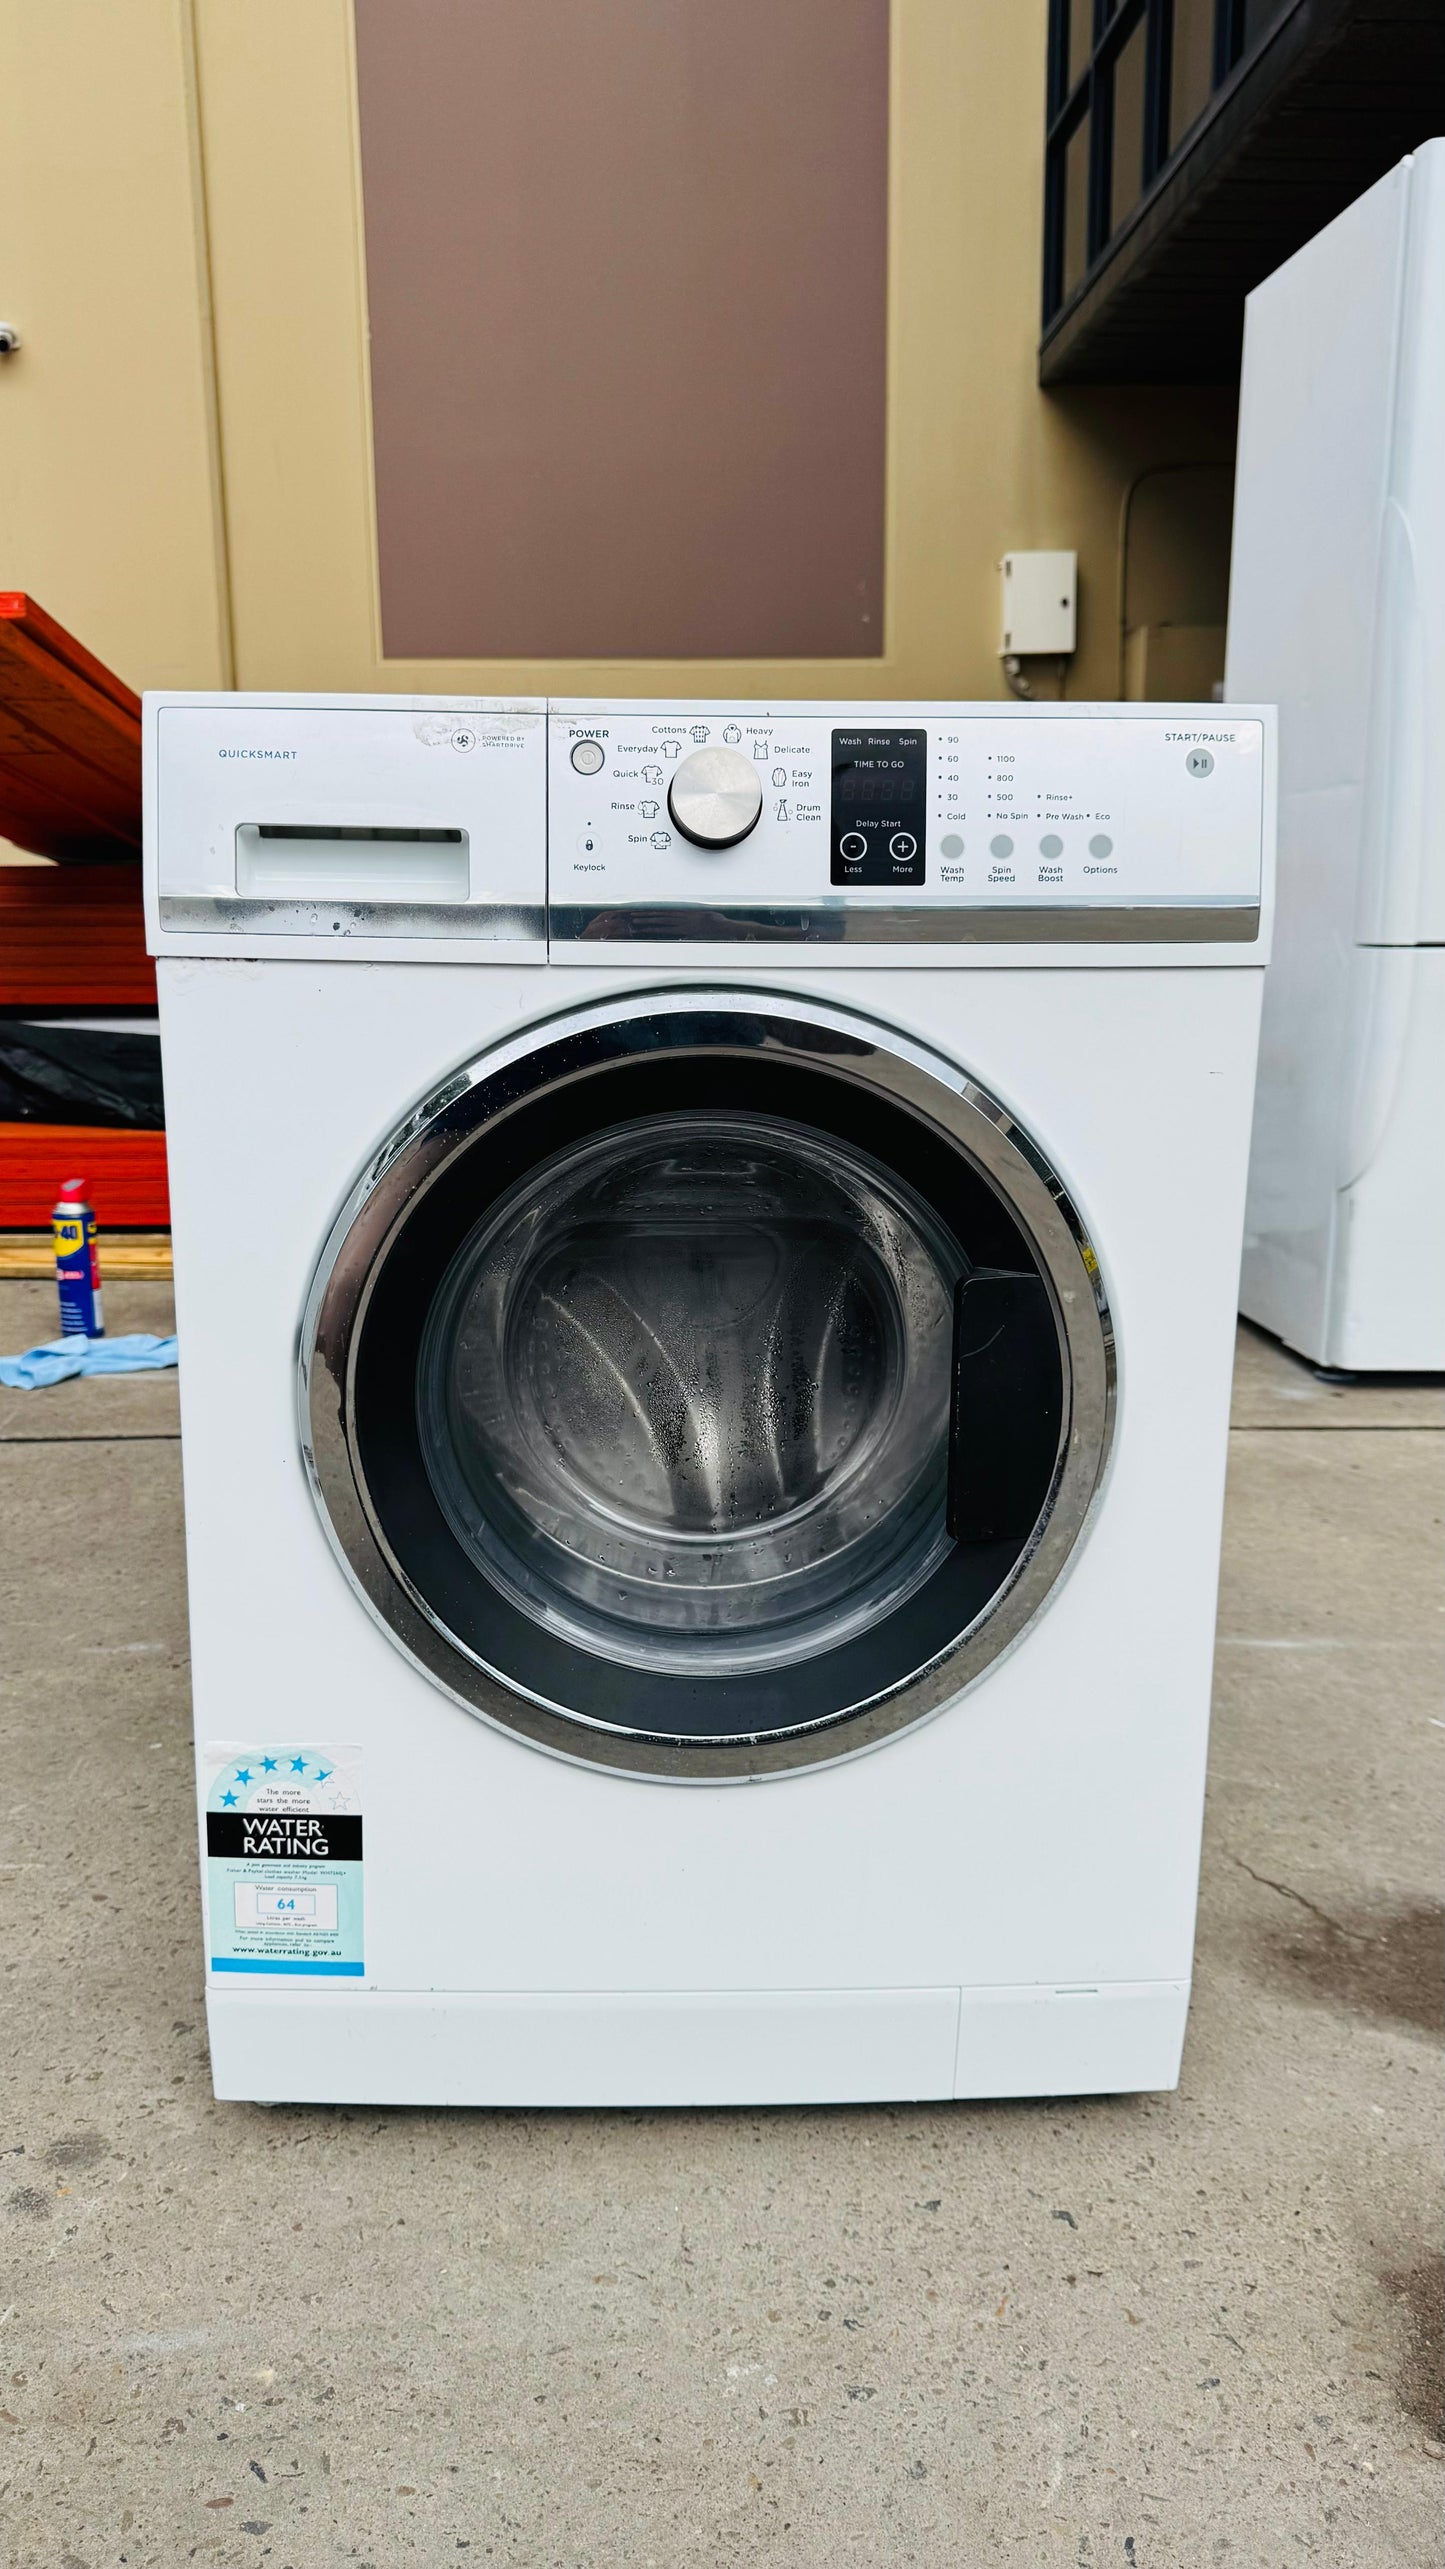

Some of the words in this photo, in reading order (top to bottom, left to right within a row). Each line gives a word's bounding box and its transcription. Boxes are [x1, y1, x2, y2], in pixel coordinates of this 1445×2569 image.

[568, 730, 609, 738] POWER
[652, 726, 686, 734] Cottons
[746, 727, 773, 736] Heavy
[1165, 733, 1236, 742] START/PAUSE
[898, 738, 917, 746] Spin
[617, 745, 658, 754] Everyday
[774, 746, 810, 754] Delicate
[219, 749, 297, 760] QUICKSMART
[854, 760, 874, 768] TIME
[613, 770, 638, 778] Quick
[792, 771, 812, 779] Easy
[611, 802, 635, 810] Rinse
[796, 813, 821, 821] Clean
[1010, 813, 1028, 821] Spin
[856, 820, 879, 828] Delay
[628, 835, 648, 843] Spin
[573, 863, 606, 872] Keylock
[940, 866, 964, 874] Wash
[992, 866, 1012, 874] Spin
[1039, 866, 1063, 874] Wash
[1083, 866, 1118, 874] Options
[940, 875, 964, 883] Temp
[988, 875, 1016, 883] Speed
[243, 1818, 323, 1836] WATER
[243, 1837, 329, 1855] RATING
[277, 1898, 295, 1910] 64
[232, 1946, 342, 1957] www.waterrating.gov.au
